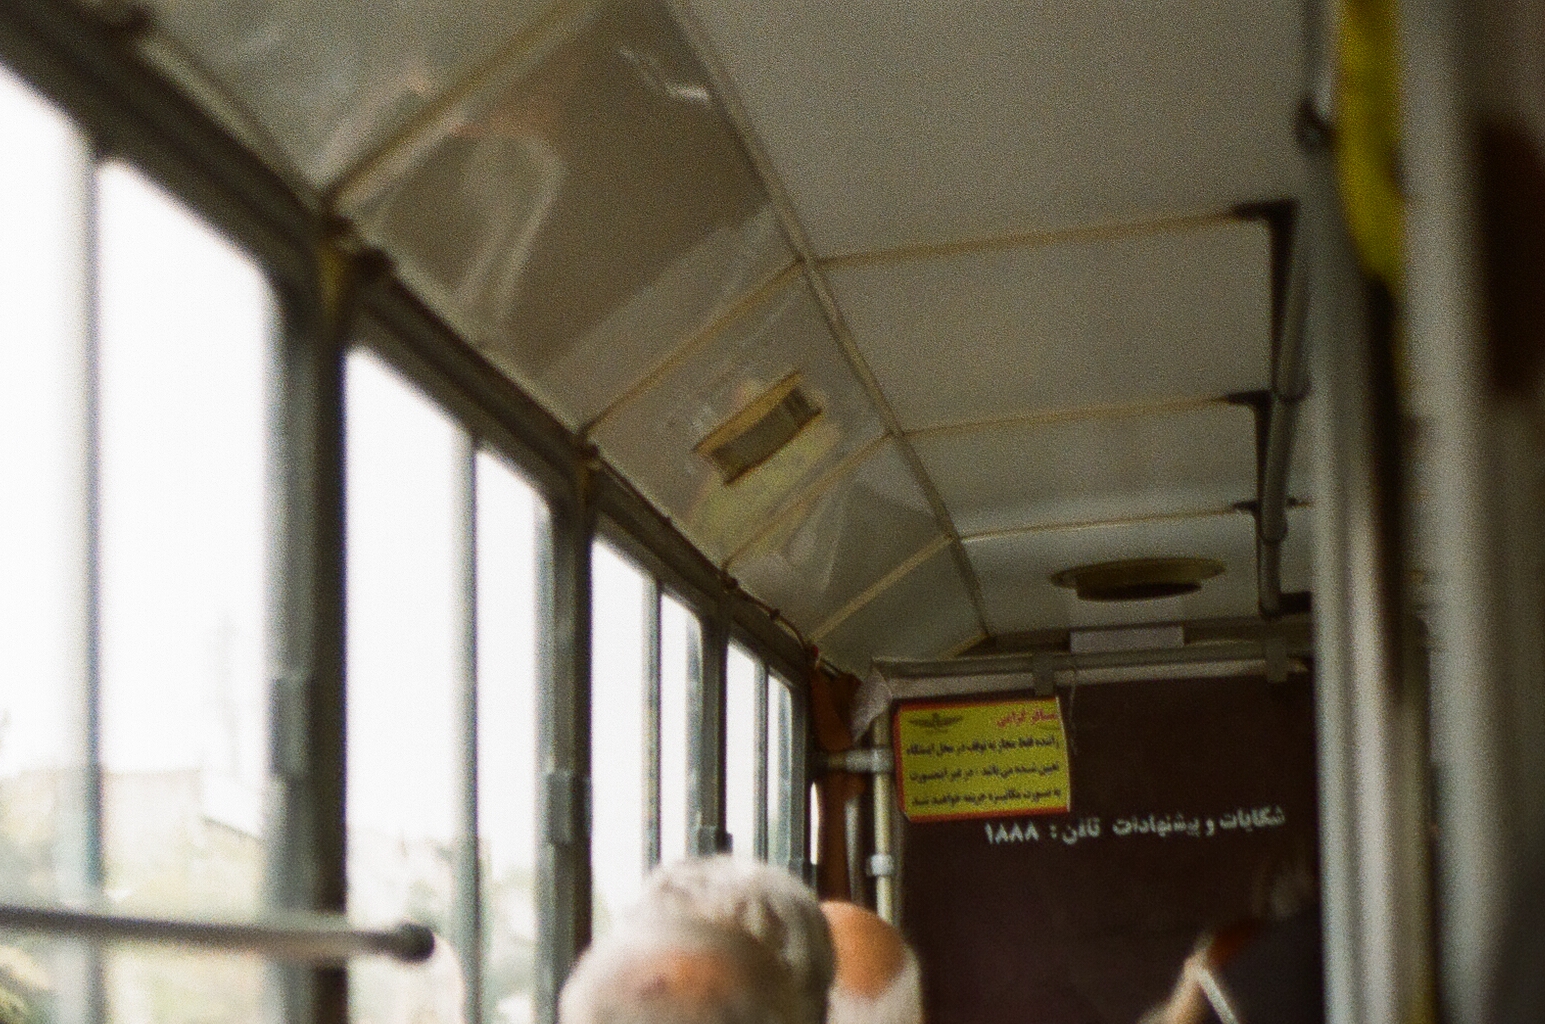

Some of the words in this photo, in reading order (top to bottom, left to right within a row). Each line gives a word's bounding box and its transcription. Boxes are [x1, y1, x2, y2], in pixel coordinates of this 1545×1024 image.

[1111, 810, 1201, 837] پیشنهادات
[1205, 817, 1215, 836] و
[1219, 804, 1286, 832] شکایات
[984, 821, 1040, 845] ۱۸۸۸
